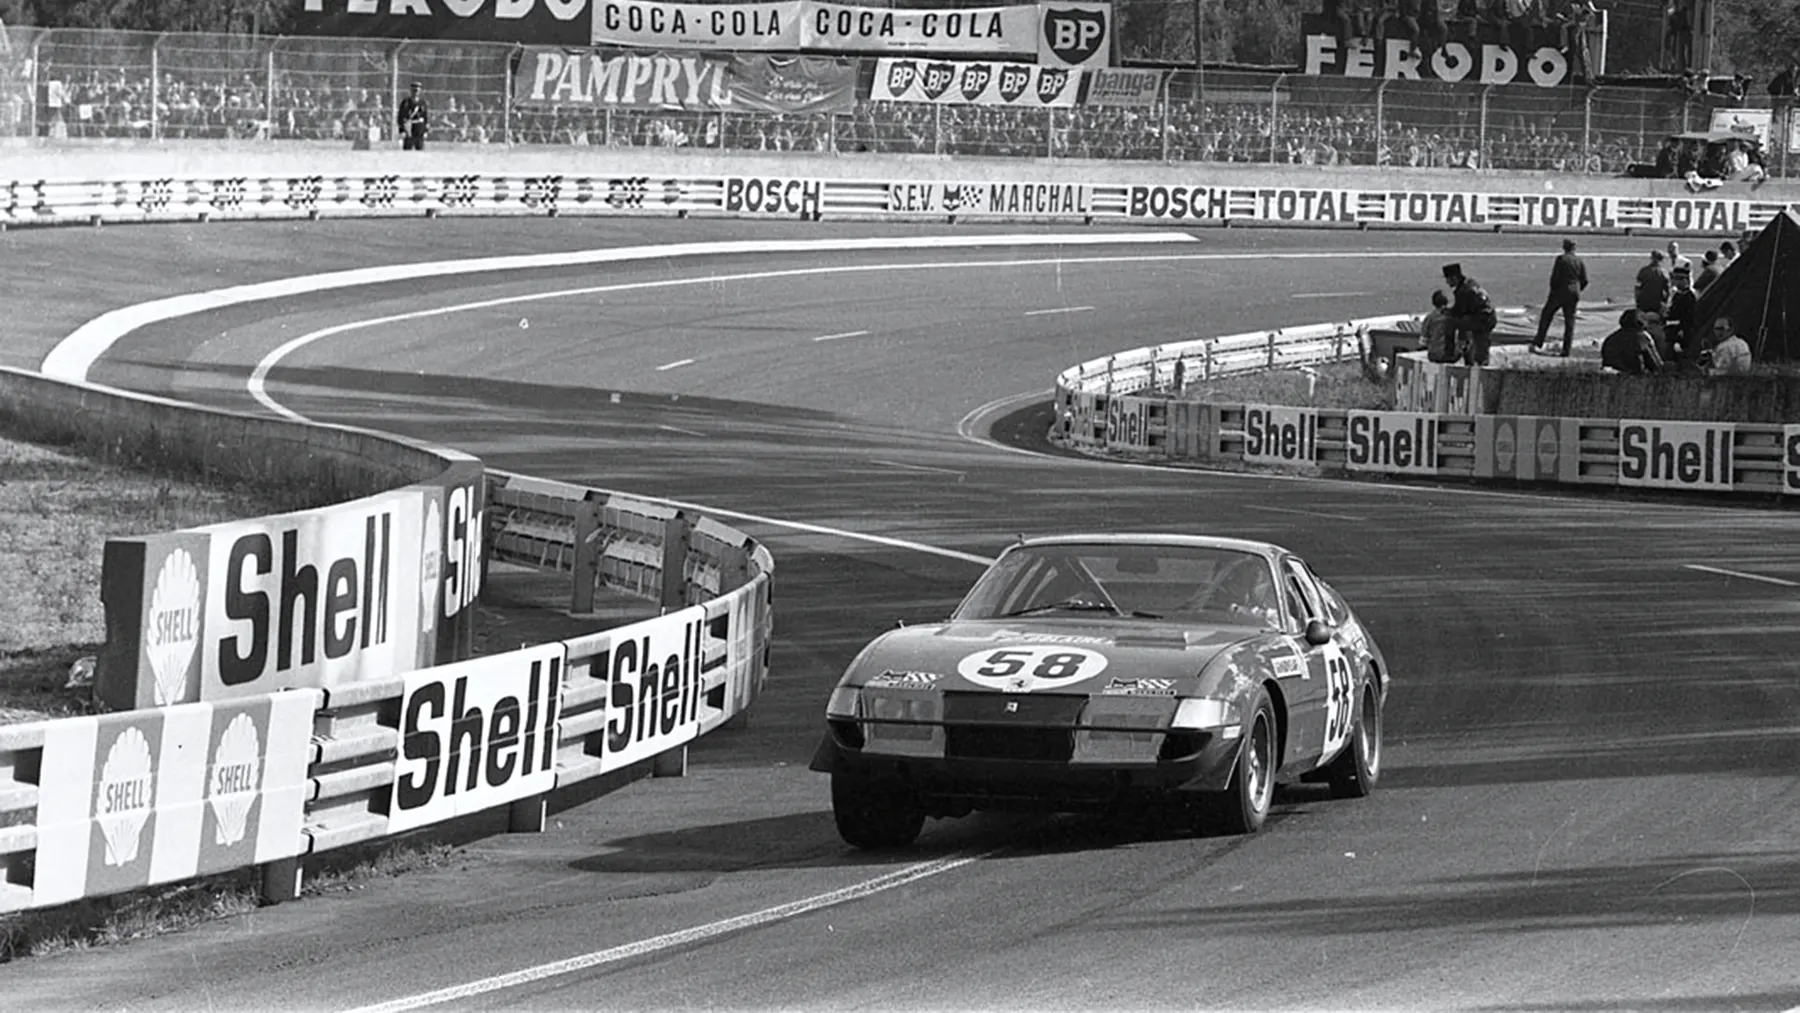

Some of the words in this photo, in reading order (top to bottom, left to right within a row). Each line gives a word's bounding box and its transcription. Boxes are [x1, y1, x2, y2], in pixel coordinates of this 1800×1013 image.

[1052, 19, 1100, 50] BP
[530, 52, 732, 105] PAMPRYL
[1305, 34, 1568, 88] FERODO
[889, 66, 916, 89] BP
[927, 69, 952, 91] BP
[963, 69, 988, 92] BP
[1002, 72, 1028, 93] BP
[1039, 73, 1066, 96] BP
[726, 178, 821, 213] BOSCH
[989, 184, 1087, 213] MARCHAL
[1130, 187, 1227, 218] BOSCH
[1258, 190, 1355, 222] TOTAL
[1389, 193, 1486, 224] TOTAL
[1523, 196, 1615, 228] TOTAL
[1655, 200, 1747, 231] TOTAL
[1108, 399, 1149, 447] Shell
[1248, 409, 1316, 462] Shell
[1350, 415, 1435, 468] Shell
[1622, 425, 1731, 484] Shell
[218, 512, 391, 686] Shell
[155, 607, 193, 646] SHELL
[977, 651, 1087, 679] 58
[607, 618, 702, 753] Shell
[1328, 656, 1350, 742] 58
[397, 656, 561, 811] Shell
[105, 778, 145, 814] SHELL
[215, 763, 252, 795] SHELL
